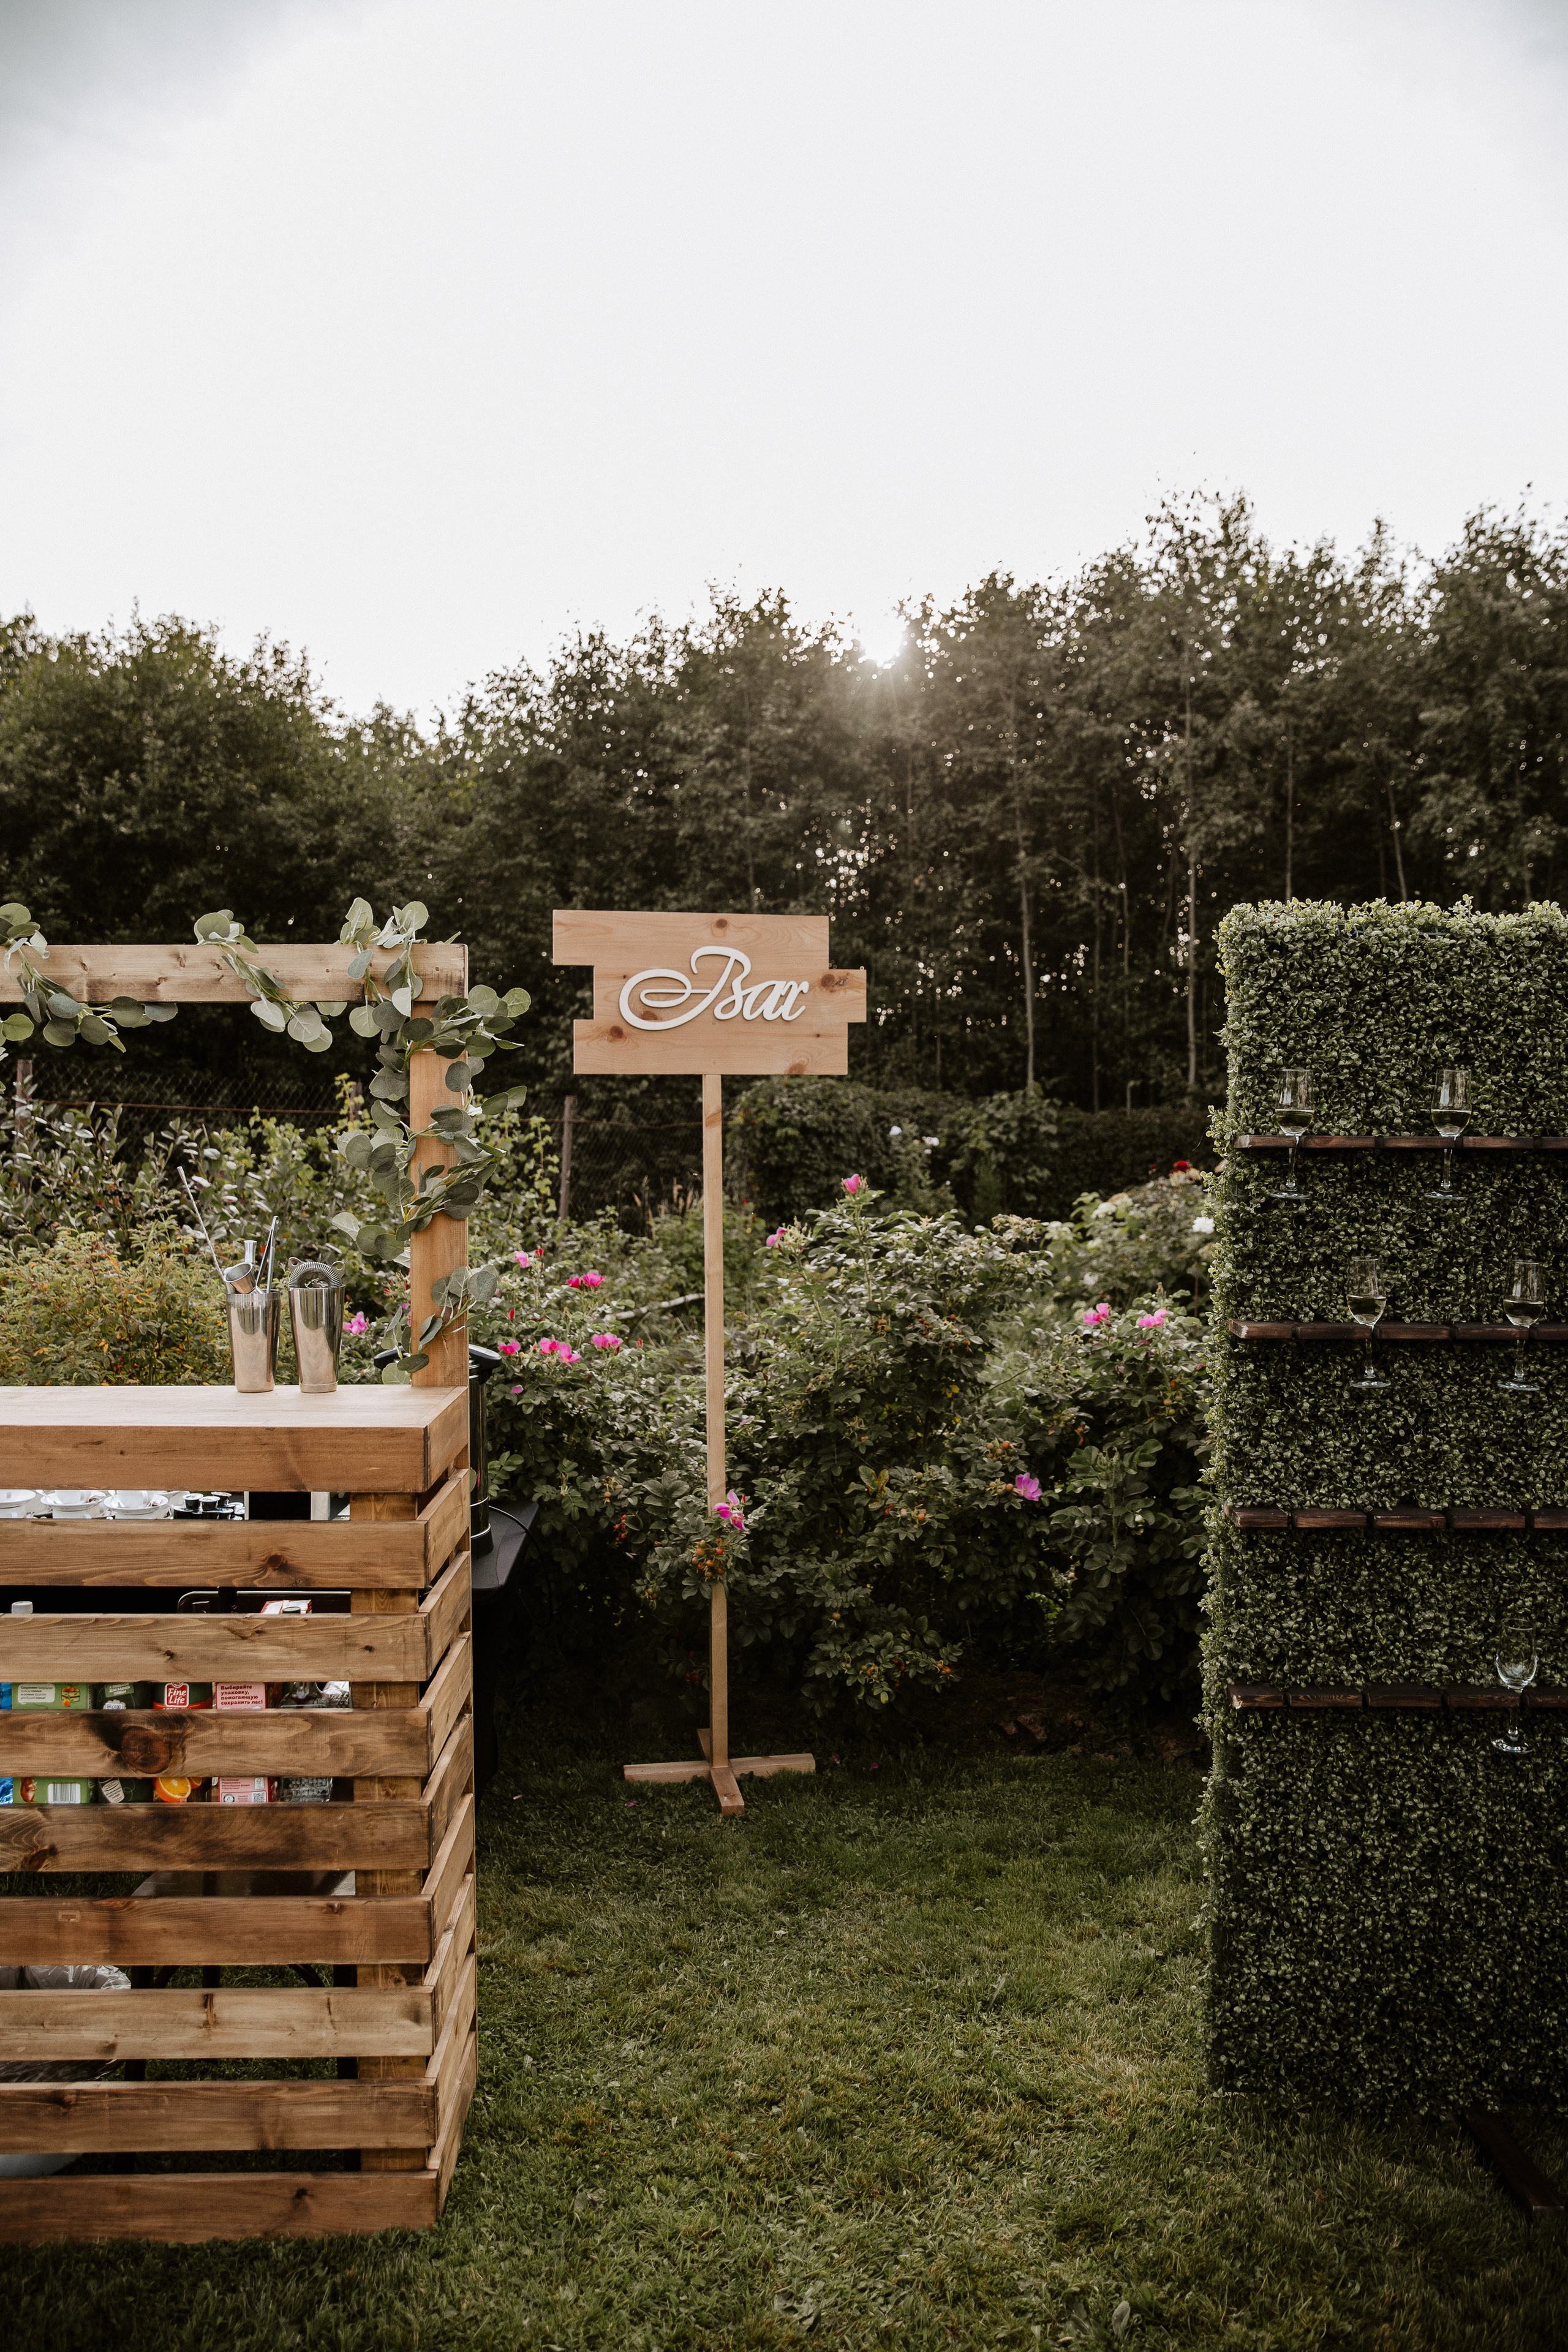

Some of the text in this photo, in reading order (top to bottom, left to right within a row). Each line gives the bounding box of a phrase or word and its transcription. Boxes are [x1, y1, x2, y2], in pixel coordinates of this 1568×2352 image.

[619, 945, 810, 1031] Bar
[168, 1688, 186, 1697] Fine
[169, 1695, 185, 1705] Life
